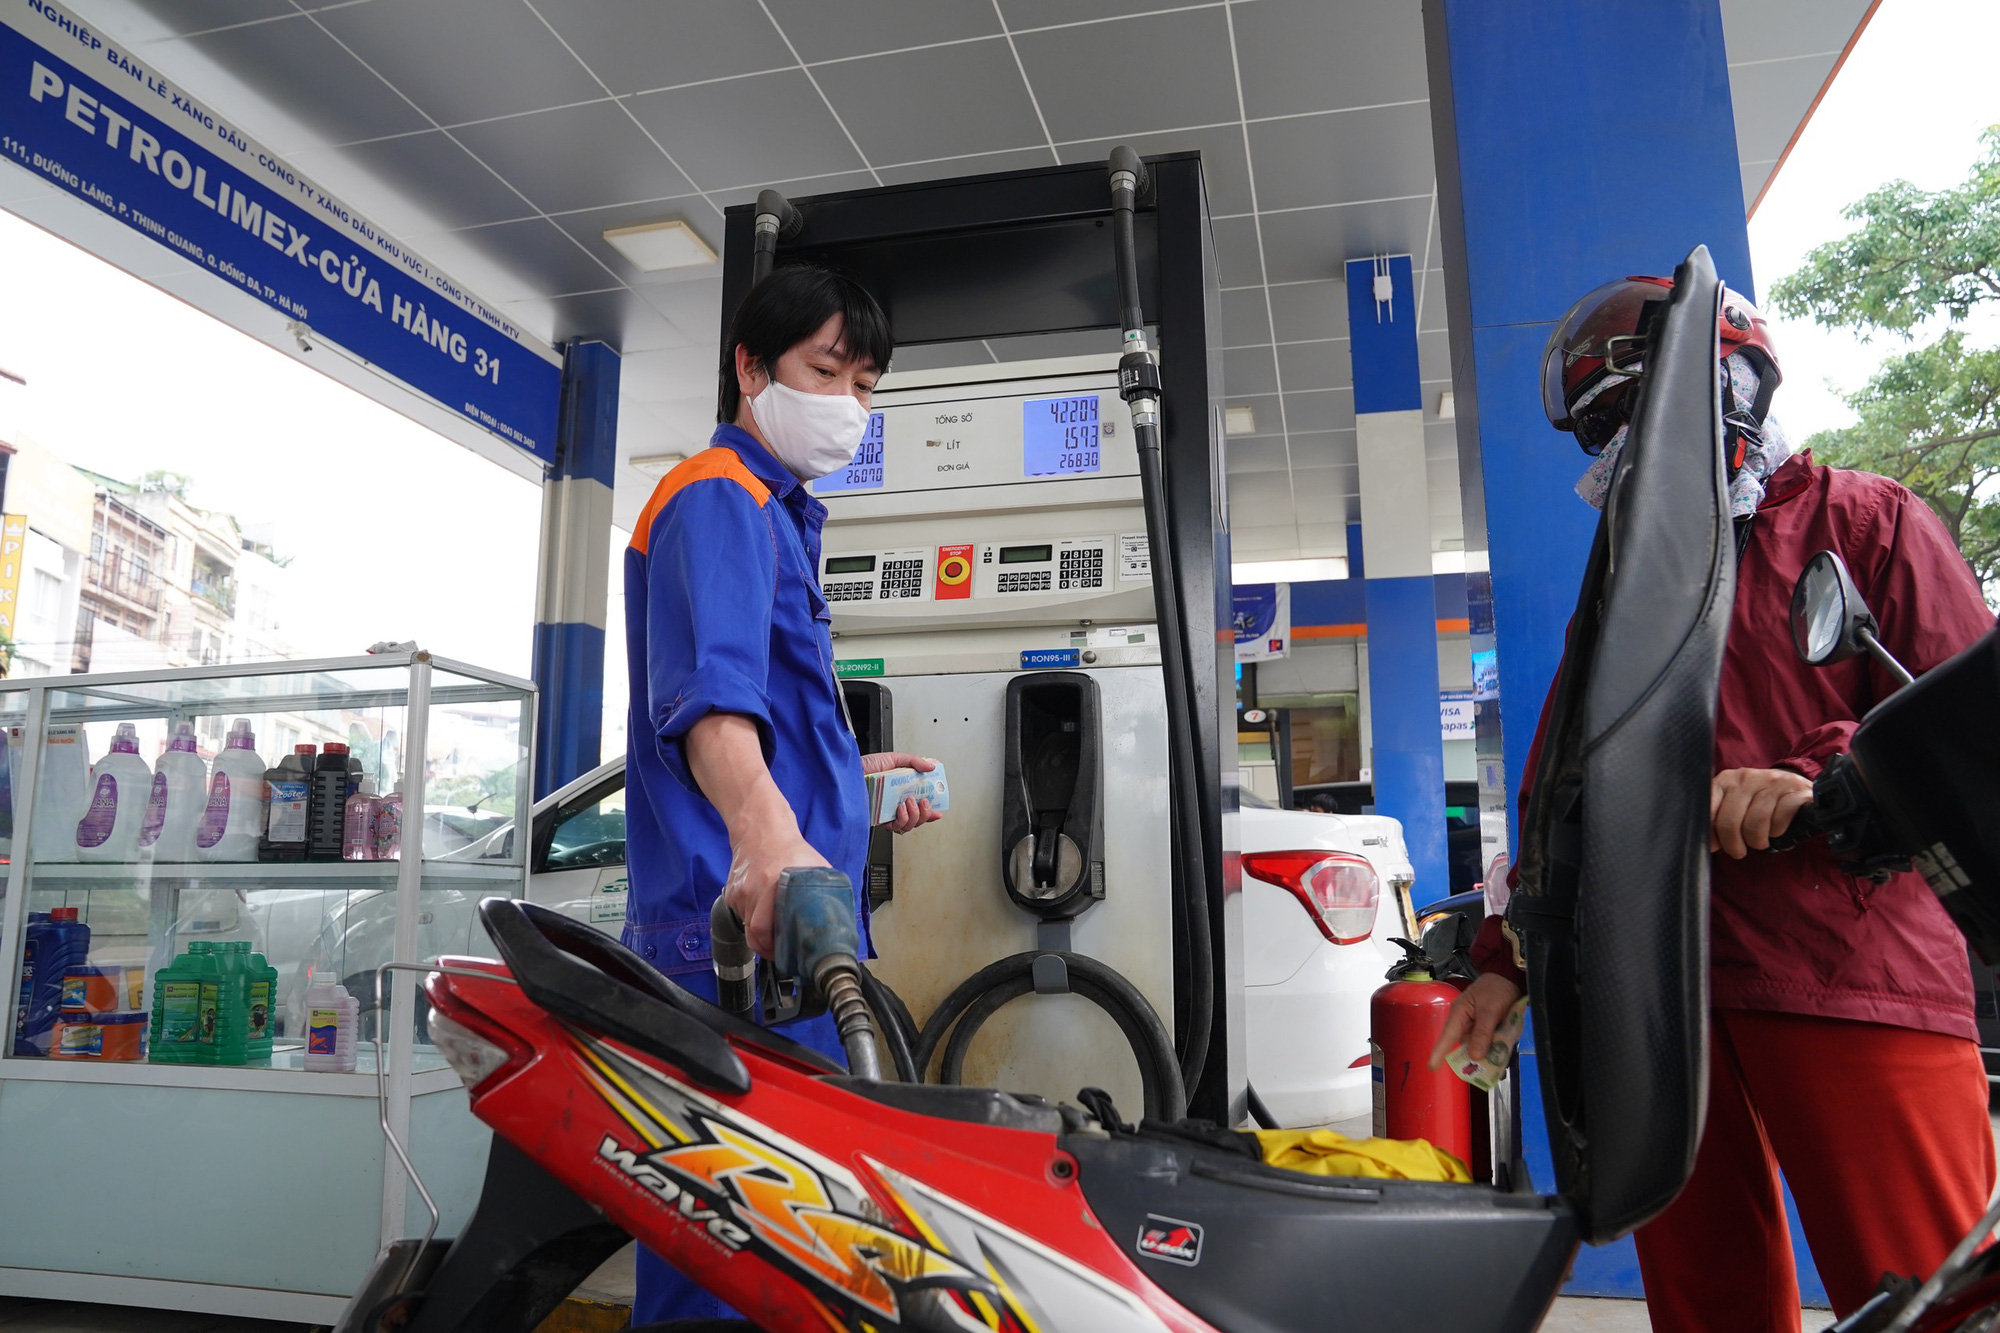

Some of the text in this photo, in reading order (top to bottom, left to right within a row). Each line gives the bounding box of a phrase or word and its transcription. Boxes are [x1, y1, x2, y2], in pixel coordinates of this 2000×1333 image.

[28, 0, 102, 50] NGHIỆP
[107, 48, 143, 83] BÁN
[148, 79, 168, 99] LẺ
[172, 93, 214, 131] XĂNG
[218, 126, 248, 153] DẦU
[258, 153, 295, 186] CÔNG
[299, 180, 315, 199] TY
[316, 194, 350, 224] XĂNG
[352, 218, 376, 241] DẦU
[377, 235, 400, 258] KHU
[402, 252, 423, 275] VỰC
[436, 276, 463, 301] CÔNG
[463, 295, 476, 311] TY
[477, 304, 501, 330] TNHH
[502, 322, 520, 340] MTV
[3, 136, 308, 320] 111, ĐƯỜNG LÁNG, P. THỊNH QUANG, Q. ĐỐNG ĐA, TP. HÀ NỘI
[391, 293, 467, 363] HÀNG
[474, 347, 500, 385] 31
[935, 412, 973, 425] TỔNG SỐ
[946, 440, 961, 450] LÍT
[937, 461, 970, 473] ĐƠN GIÁ
[1059, 452, 1098, 469] 26830
[846, 468, 883, 484] 26070
[1031, 654, 1070, 663] RON95-III
[1251, 712, 1259, 721] 7
